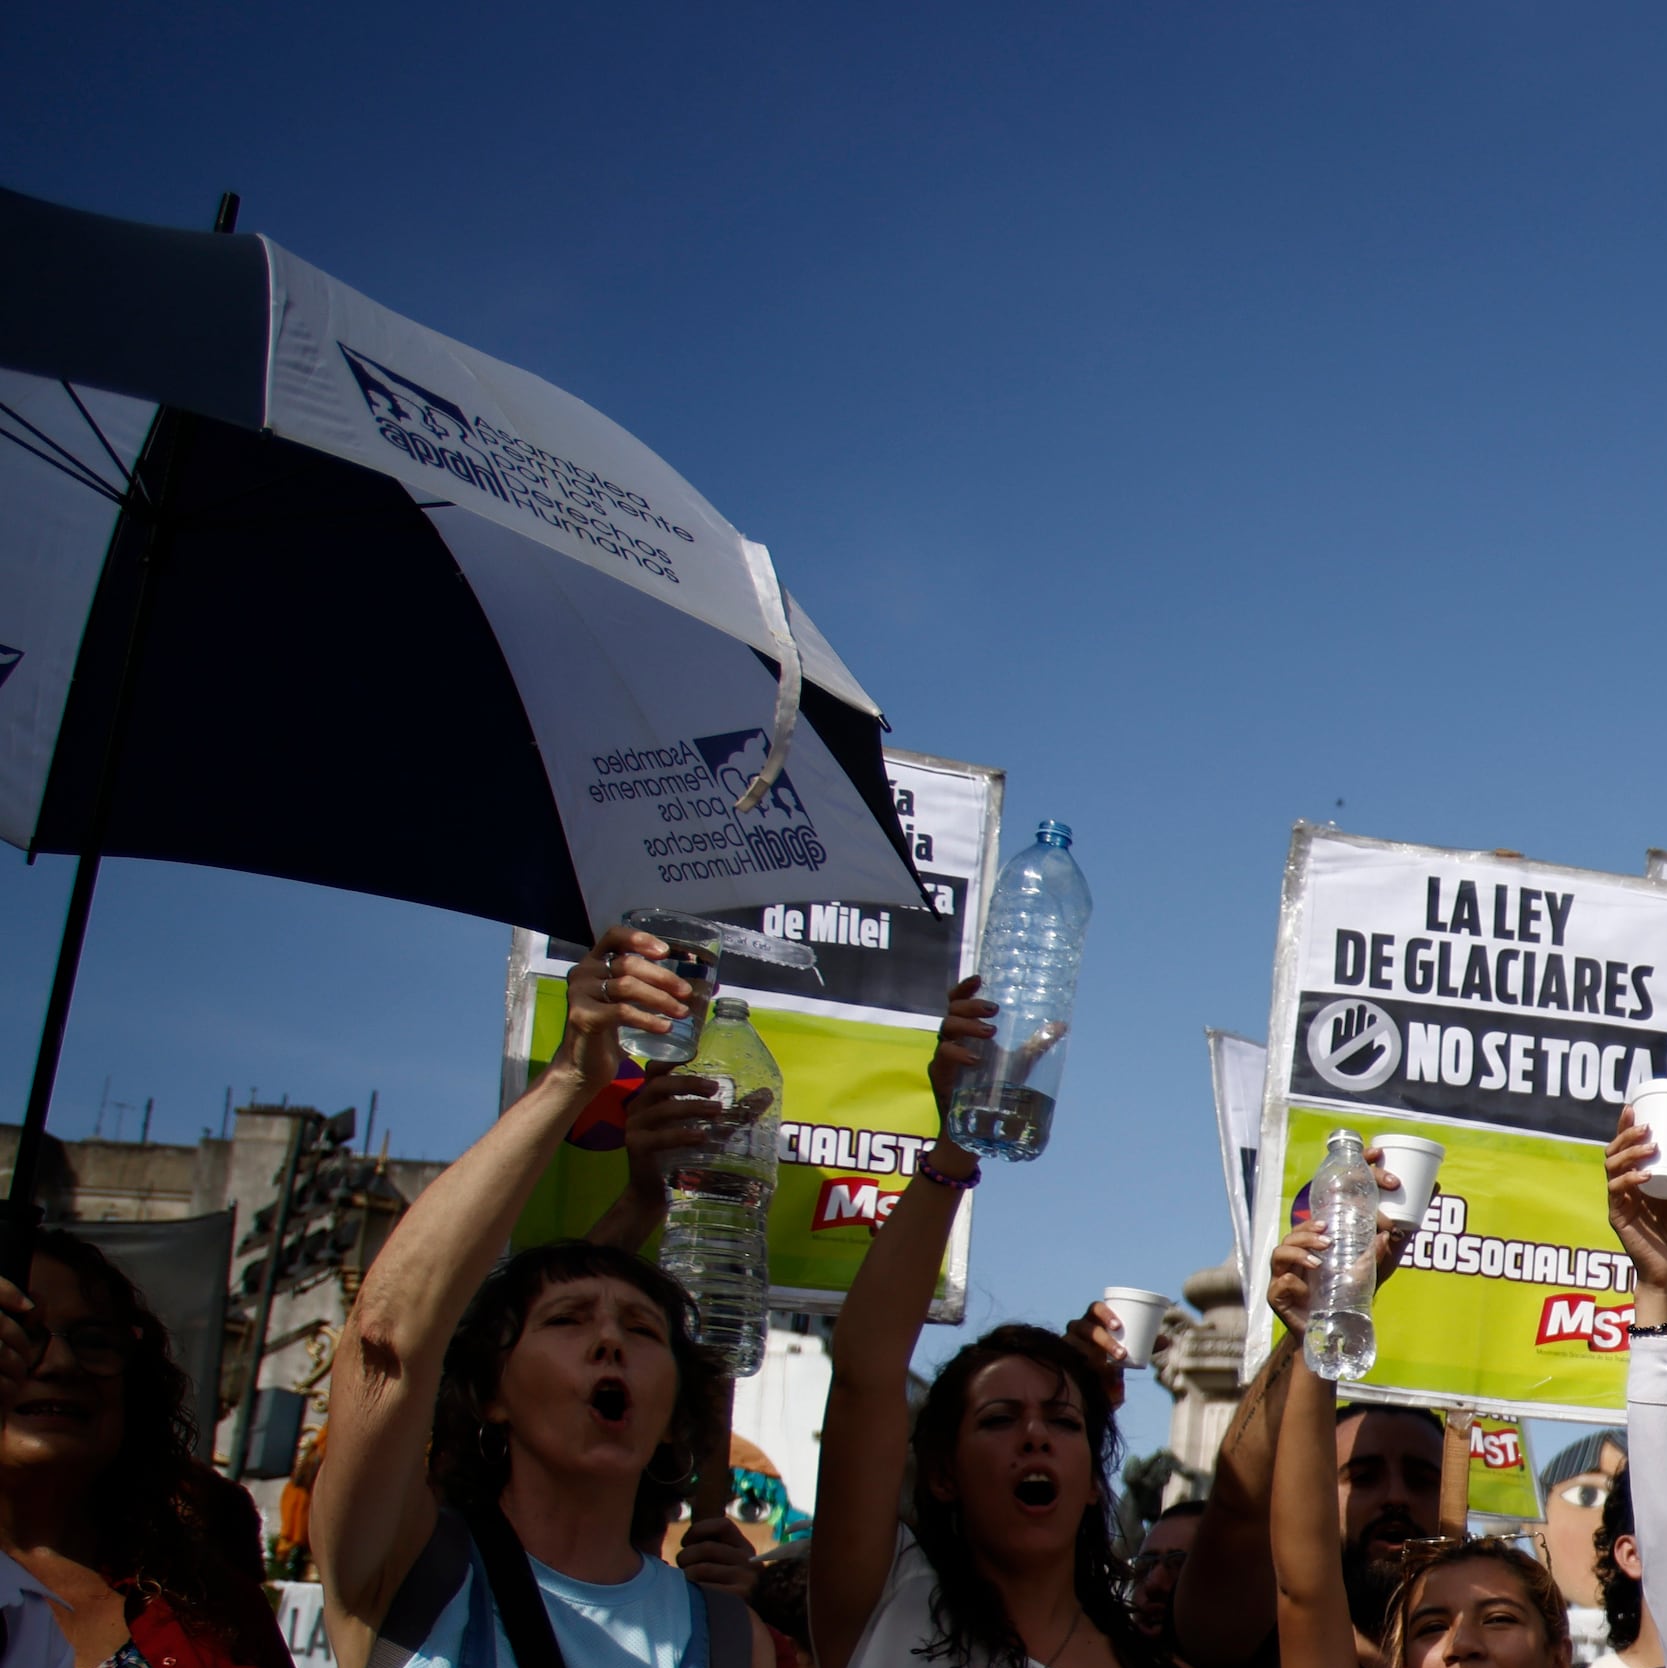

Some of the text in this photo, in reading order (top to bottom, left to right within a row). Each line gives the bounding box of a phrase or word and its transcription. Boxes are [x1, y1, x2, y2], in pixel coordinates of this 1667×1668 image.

[475, 416, 652, 511] Asamblea
[490, 451, 607, 517] por los
[502, 472, 672, 565] Derechos
[510, 490, 680, 584] Humanos
[763, 904, 804, 940] de
[810, 901, 890, 950] Milei
[1426, 876, 1575, 946] LA LEY
[1334, 928, 1654, 1021] DE GLACIARES
[1406, 1022, 1653, 1106] NO SE TOCA
[1420, 1196, 1467, 1235] ED
